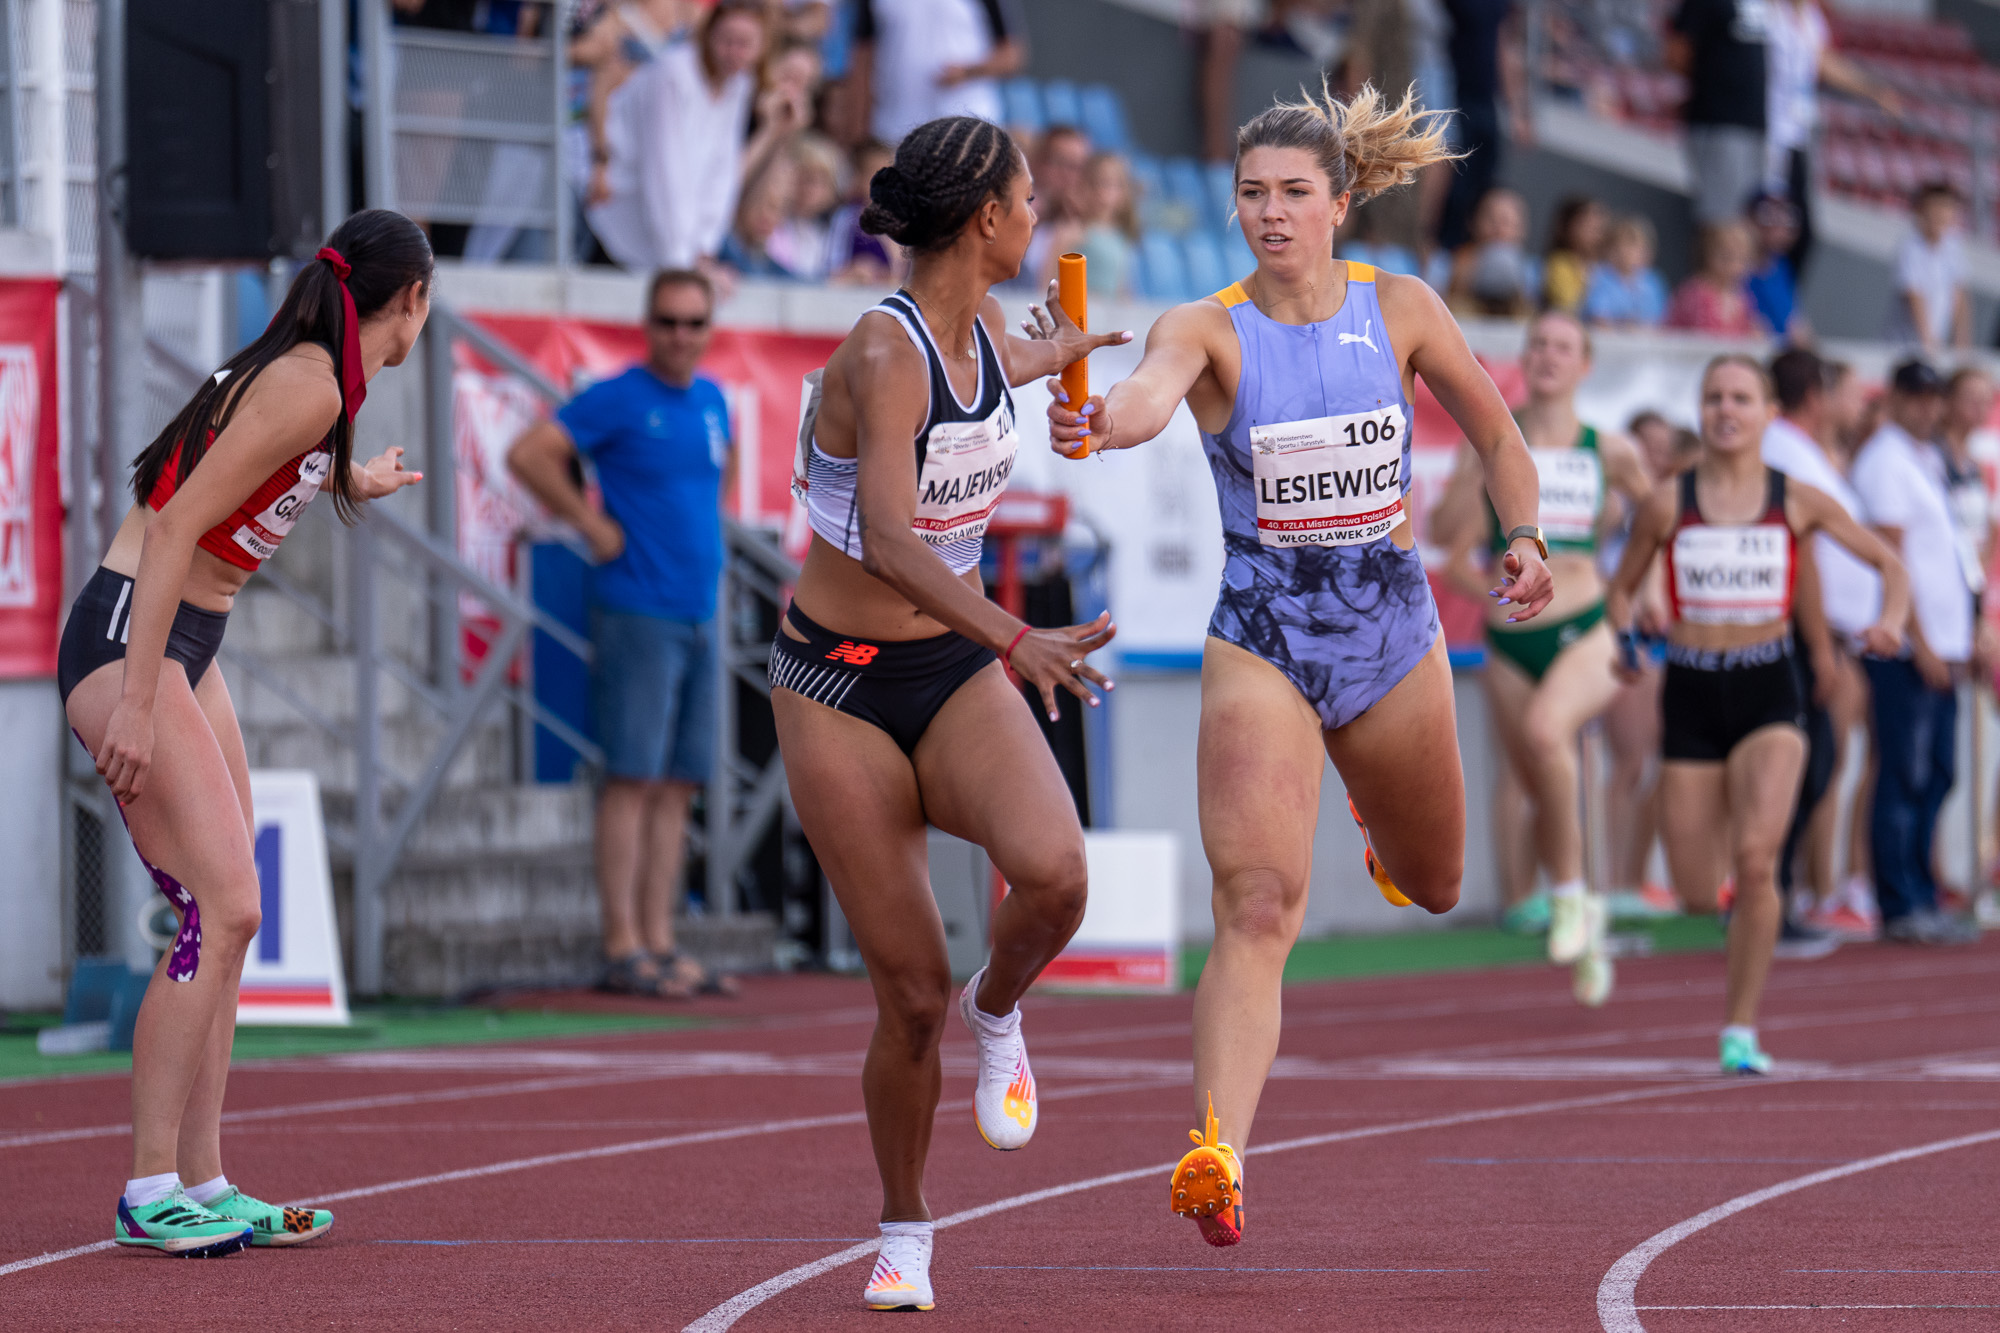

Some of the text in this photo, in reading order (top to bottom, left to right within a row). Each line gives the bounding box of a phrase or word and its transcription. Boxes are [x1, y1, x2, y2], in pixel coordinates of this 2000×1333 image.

[1276, 433, 1313, 443] Ministerstwo
[1343, 415, 1396, 447] 106
[1277, 442, 1296, 451] Sportu
[1301, 438, 1326, 448] Turystyki
[1260, 457, 1400, 505] LESIEWICZ
[912, 519, 928, 528] 40.
[929, 521, 949, 530] PZLA
[1266, 503, 1398, 530] 40. PZLA Mistrzostwa Polski U23
[1277, 520, 1391, 543] WŁOCŁAWEK 2023
